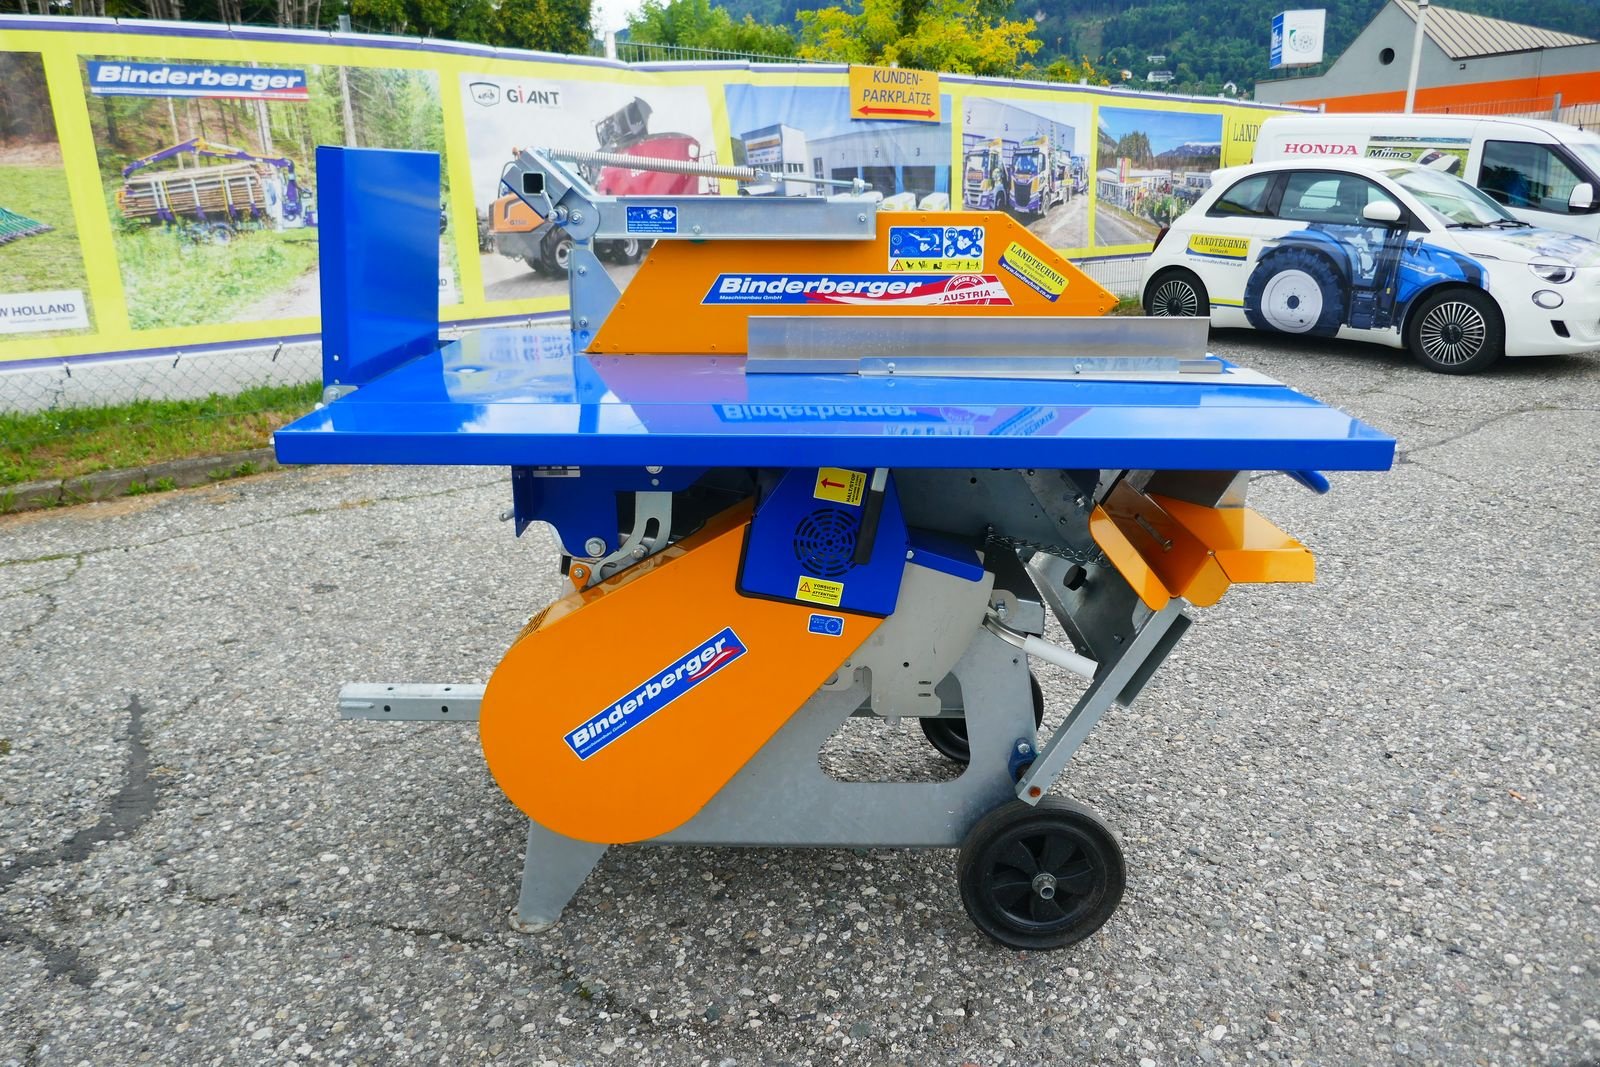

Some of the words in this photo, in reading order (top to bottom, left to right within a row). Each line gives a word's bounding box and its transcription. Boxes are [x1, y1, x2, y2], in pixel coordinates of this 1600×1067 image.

[97, 65, 302, 91] Binderberger
[873, 70, 923, 85] KUNDEN-
[863, 87, 931, 105] PARKPLÄTZE
[1233, 123, 1261, 142] LAND
[1284, 143, 1358, 155] HONDA
[1369, 147, 1412, 159] Miimo
[1193, 236, 1248, 249] LANDTECHNIK
[1010, 244, 1066, 287] LANDTECHNIK
[719, 277, 923, 297] Binderberger
[953, 276, 971, 287] MADE
[943, 289, 991, 302] AUSTRIA
[12, 303, 75, 317] HOLLAND
[572, 637, 726, 749] Binderberger
